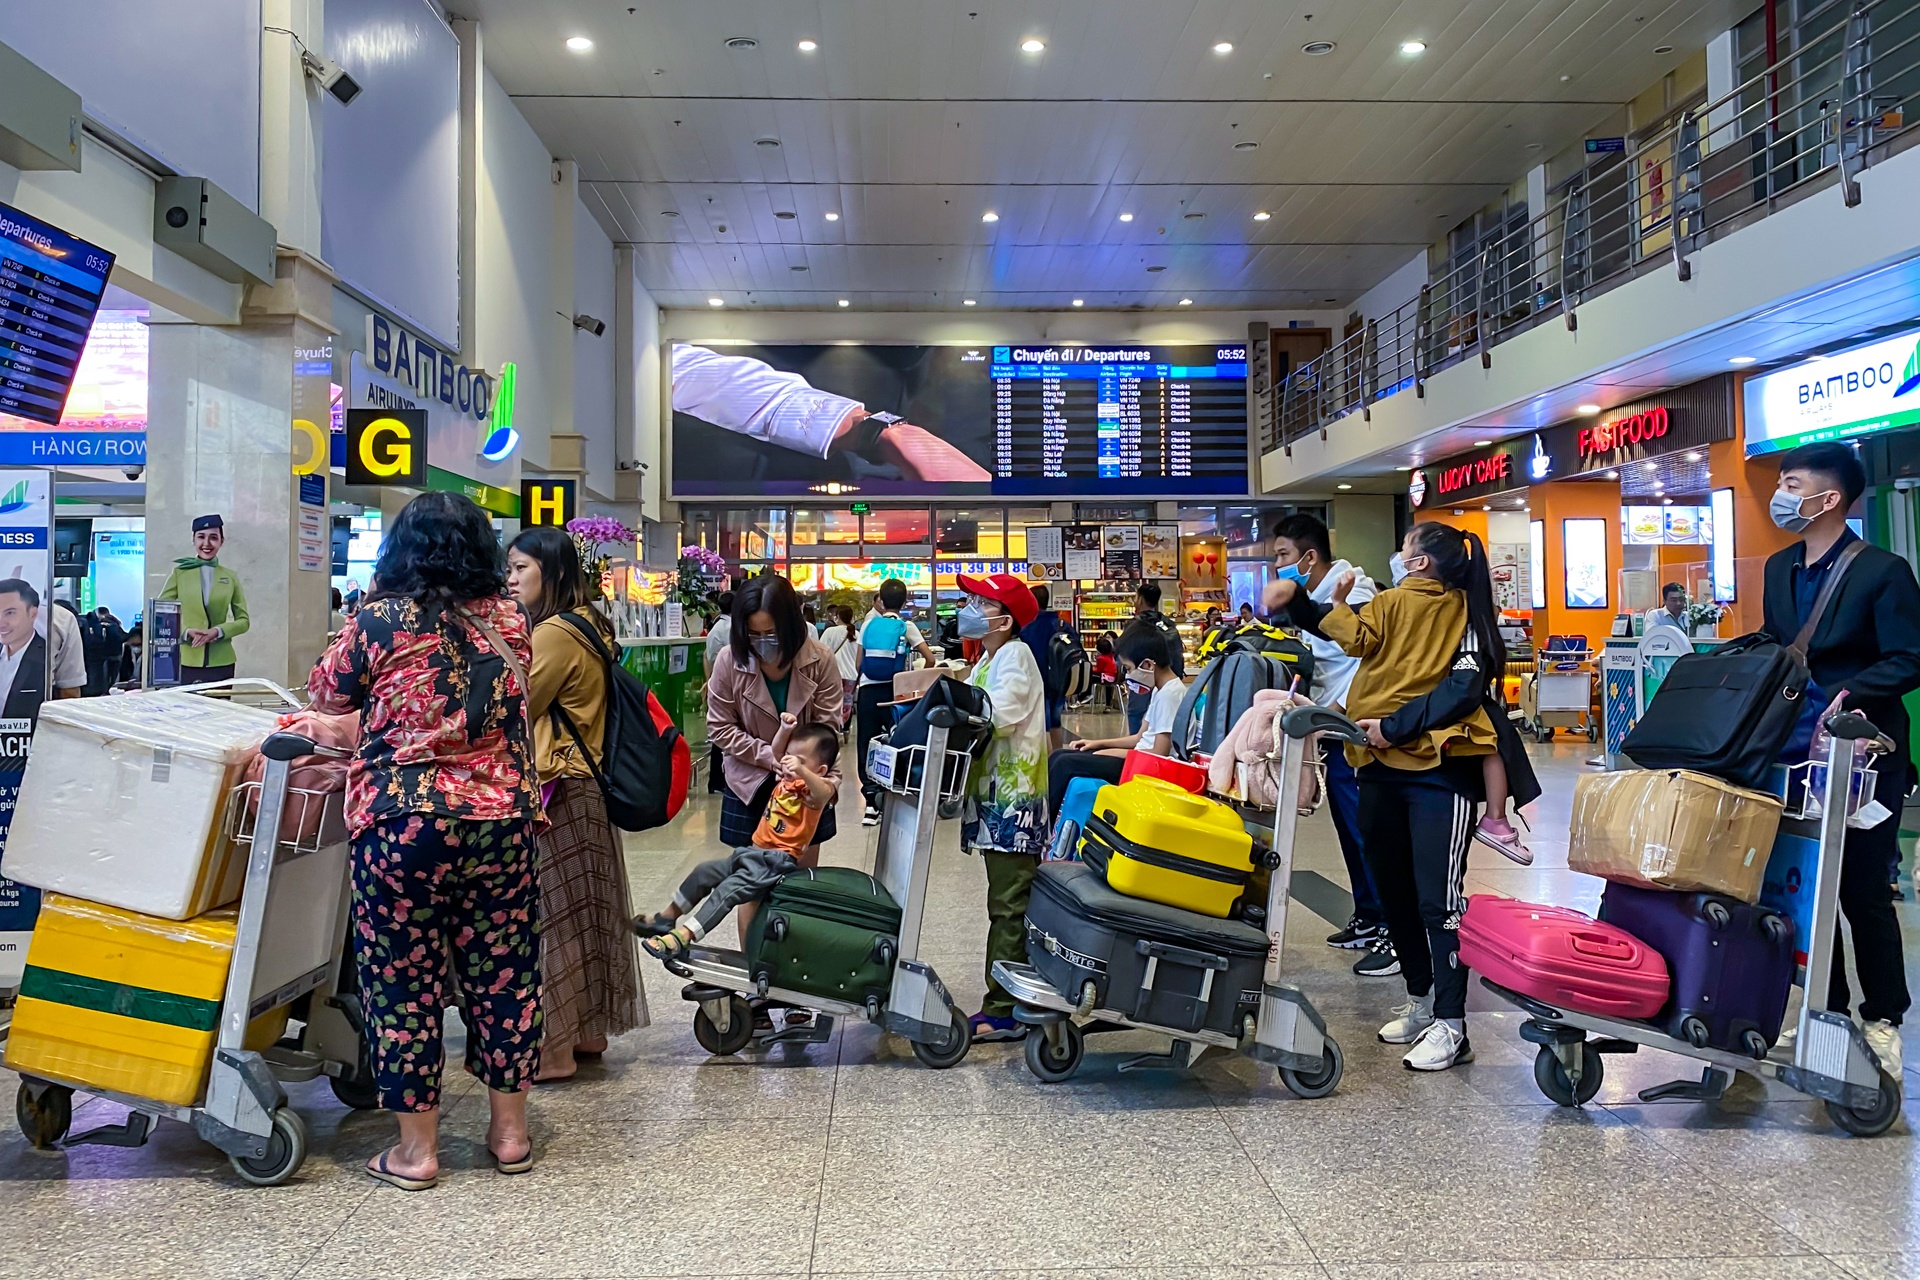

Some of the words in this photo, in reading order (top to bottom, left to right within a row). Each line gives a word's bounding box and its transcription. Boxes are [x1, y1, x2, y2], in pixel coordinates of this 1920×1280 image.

[0, 213, 53, 249] epartures
[86, 254, 109, 274] 05:52
[373, 313, 487, 421] BAMBOO
[1013, 348, 1059, 364] Chuyến
[1061, 348, 1074, 362] đi
[1076, 350, 1082, 362] /
[1084, 350, 1150, 364] Departures
[1217, 350, 1246, 360] 05:52
[1798, 362, 1893, 405] BAMBOO
[358, 418, 412, 476] G
[1578, 407, 1668, 457] FASTFOOD
[1438, 463, 1472, 494] LUCKY
[1476, 453, 1507, 484] CAFE
[531, 486, 564, 525] H
[6, 889, 19, 898] kgs
[1268, 930, 1281, 964] 0365
